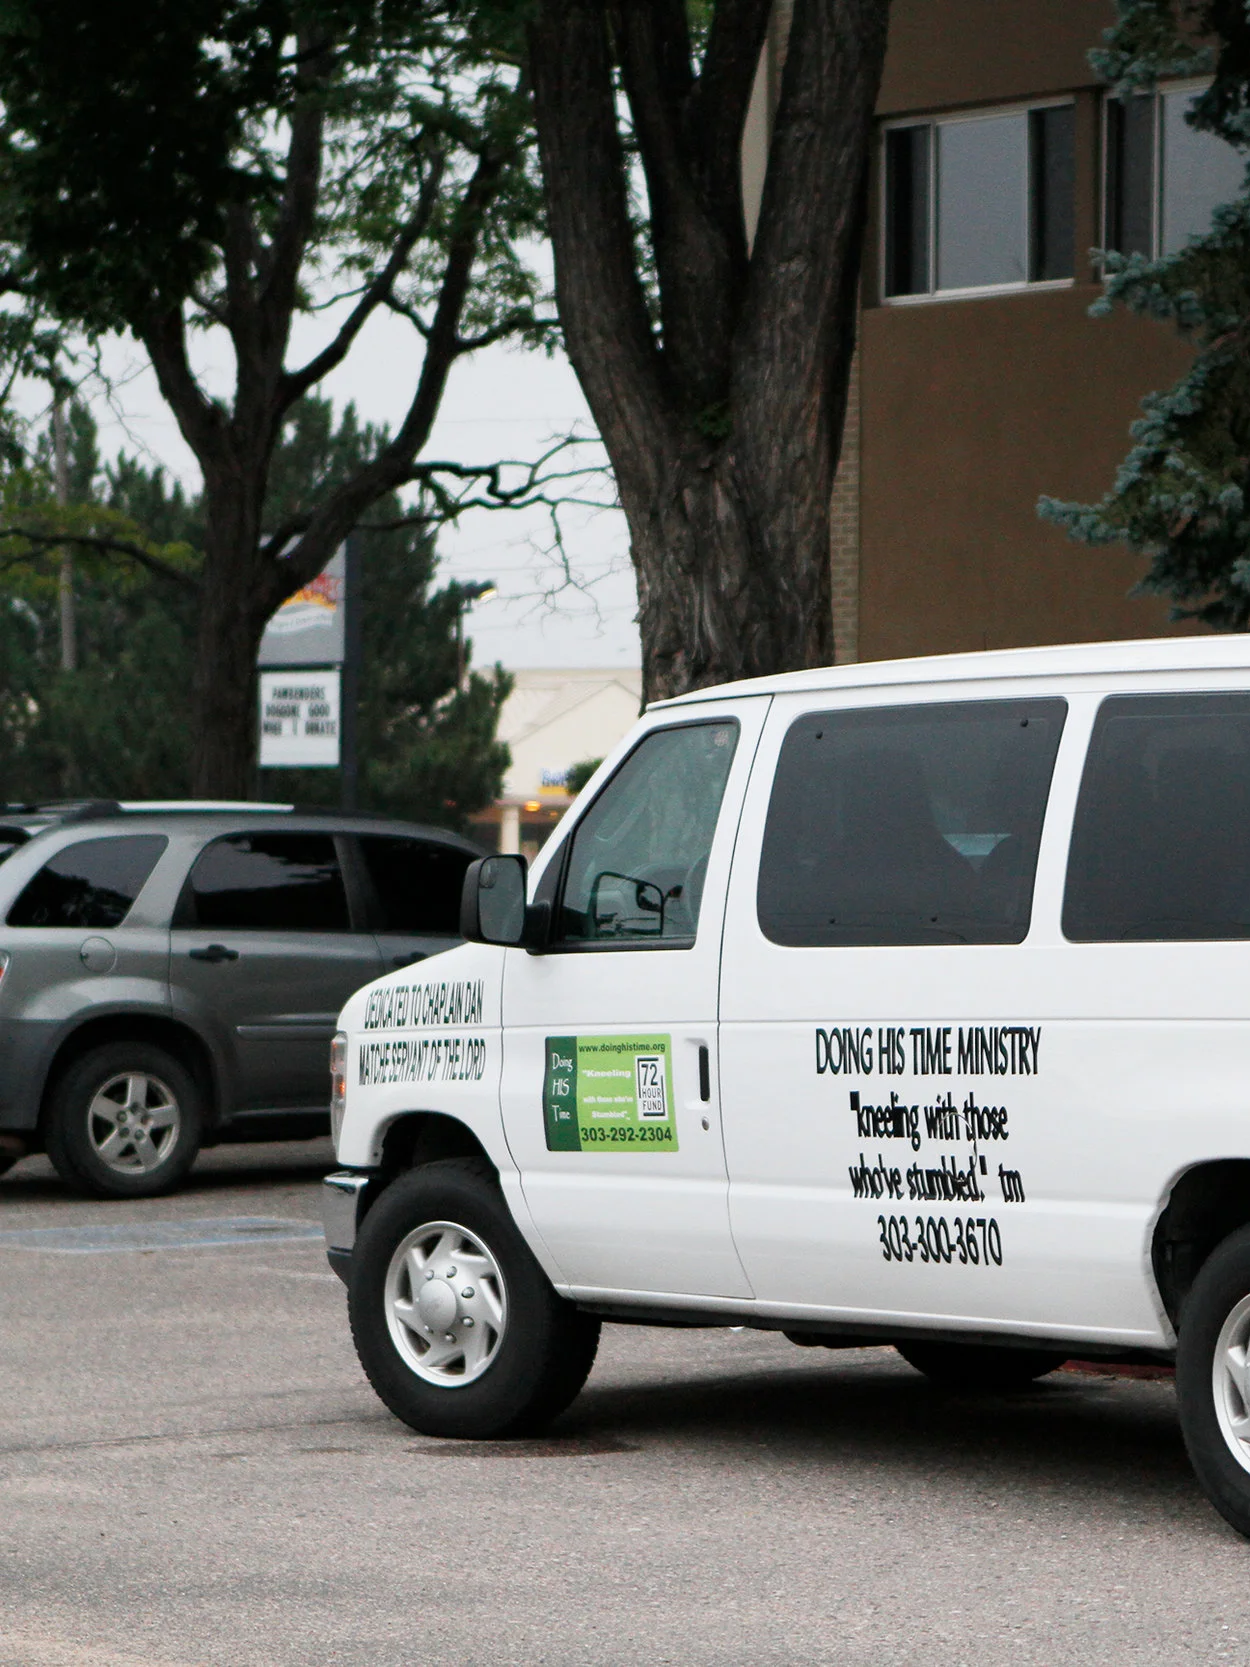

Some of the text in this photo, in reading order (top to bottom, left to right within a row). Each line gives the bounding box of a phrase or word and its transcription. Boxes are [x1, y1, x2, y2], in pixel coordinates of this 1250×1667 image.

[364, 978, 485, 1029] DEDICATED TO CHAPLAIN DAN
[578, 1043, 666, 1054] www.doinghistime.org
[816, 1026, 1042, 1075] DOING HIS TIME MINISTRY
[389, 1039, 429, 1083] SERVANT
[428, 1039, 442, 1081] OF
[441, 1038, 461, 1080] THE
[459, 1038, 486, 1080] LORD
[552, 1053, 573, 1072] Doing
[641, 1063, 658, 1086] 72
[552, 1078, 570, 1096] HIS
[642, 1088, 662, 1098] HOUR
[552, 1105, 571, 1122] Time
[643, 1101, 661, 1111] FUND
[923, 1091, 961, 1140] with
[962, 1091, 1009, 1141] those
[581, 1127, 672, 1142] 303-292-2304
[849, 1153, 904, 1200] who've
[997, 1163, 1026, 1202] tm
[877, 1215, 1003, 1266] 303-300-3670
